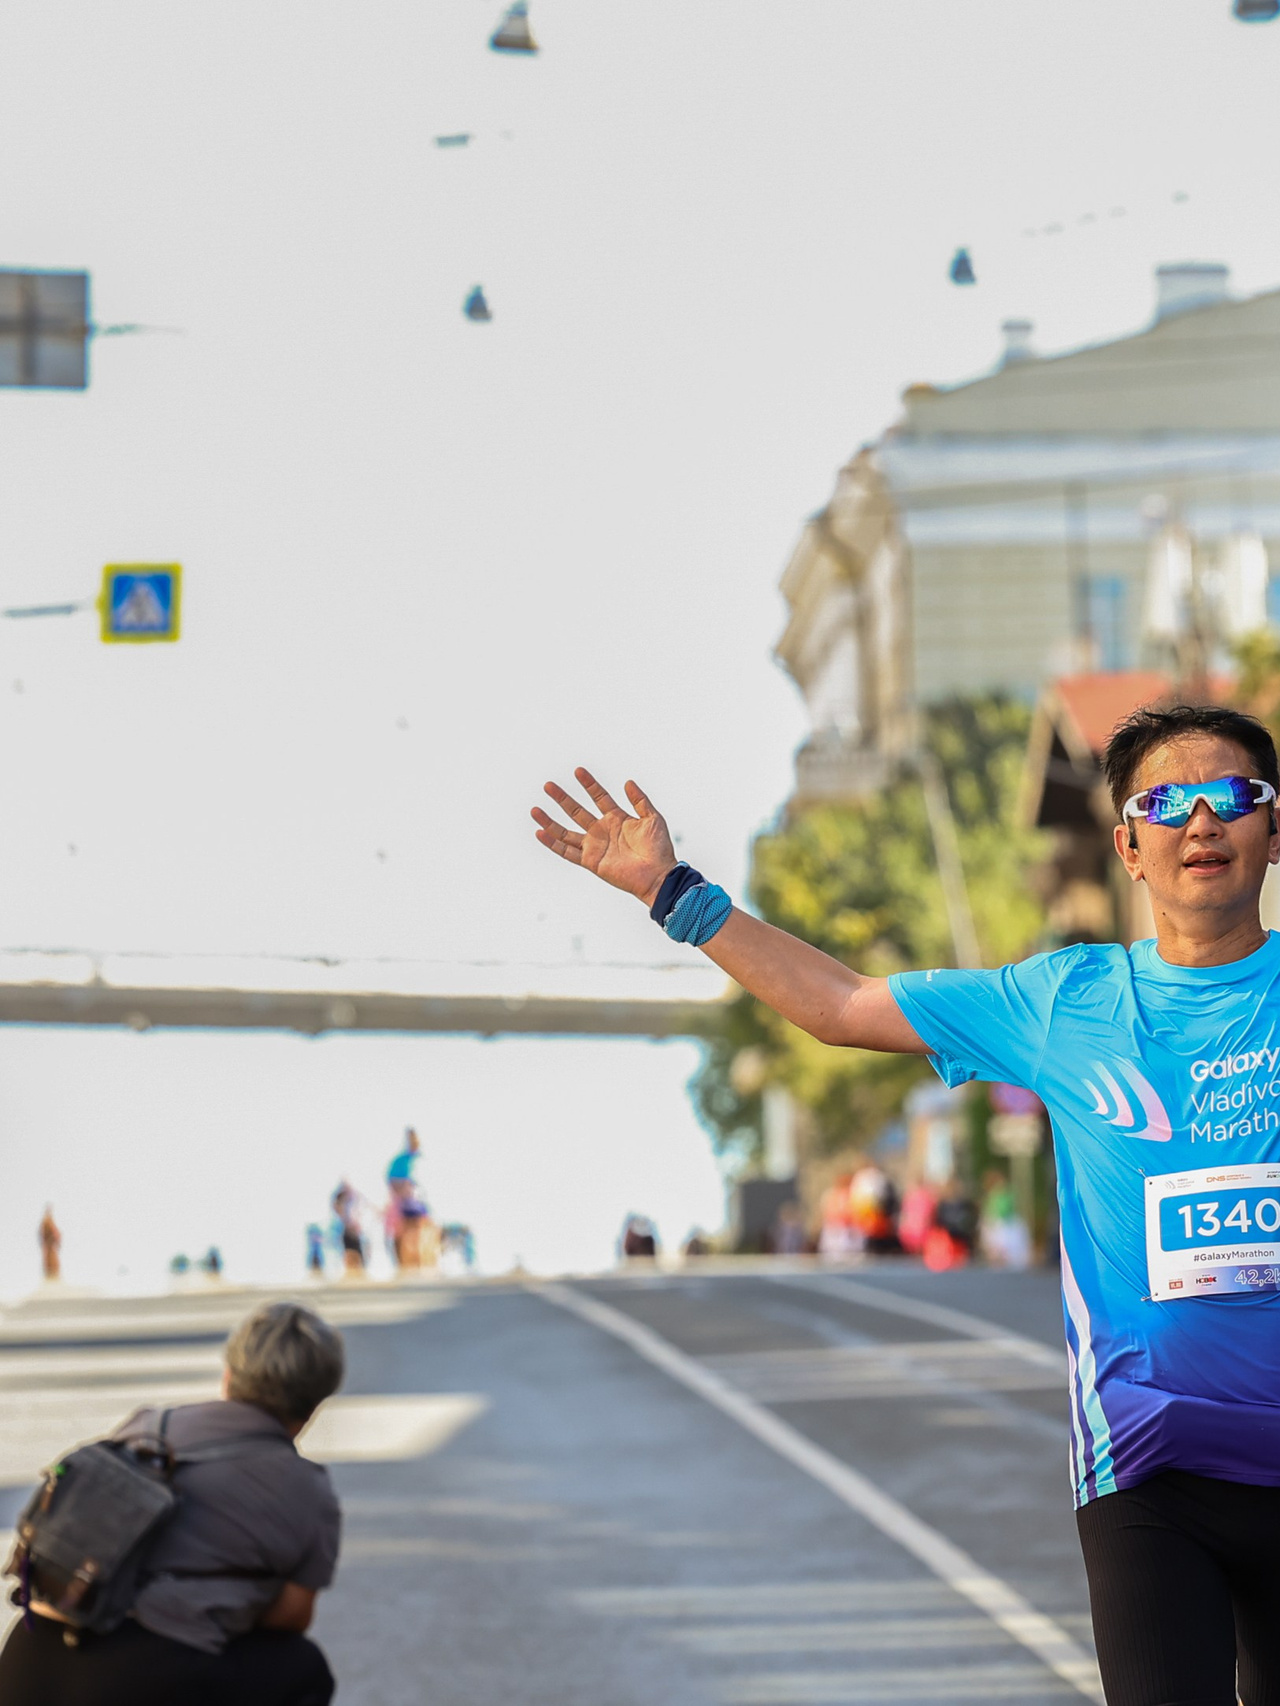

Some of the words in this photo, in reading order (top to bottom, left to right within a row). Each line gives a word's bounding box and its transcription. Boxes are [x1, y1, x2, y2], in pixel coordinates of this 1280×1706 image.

[1189, 1047, 1280, 1082] Galaxy
[1206, 1175, 1226, 1184] DNS
[1193, 1249, 1275, 1261] #GalaxyMarathon
